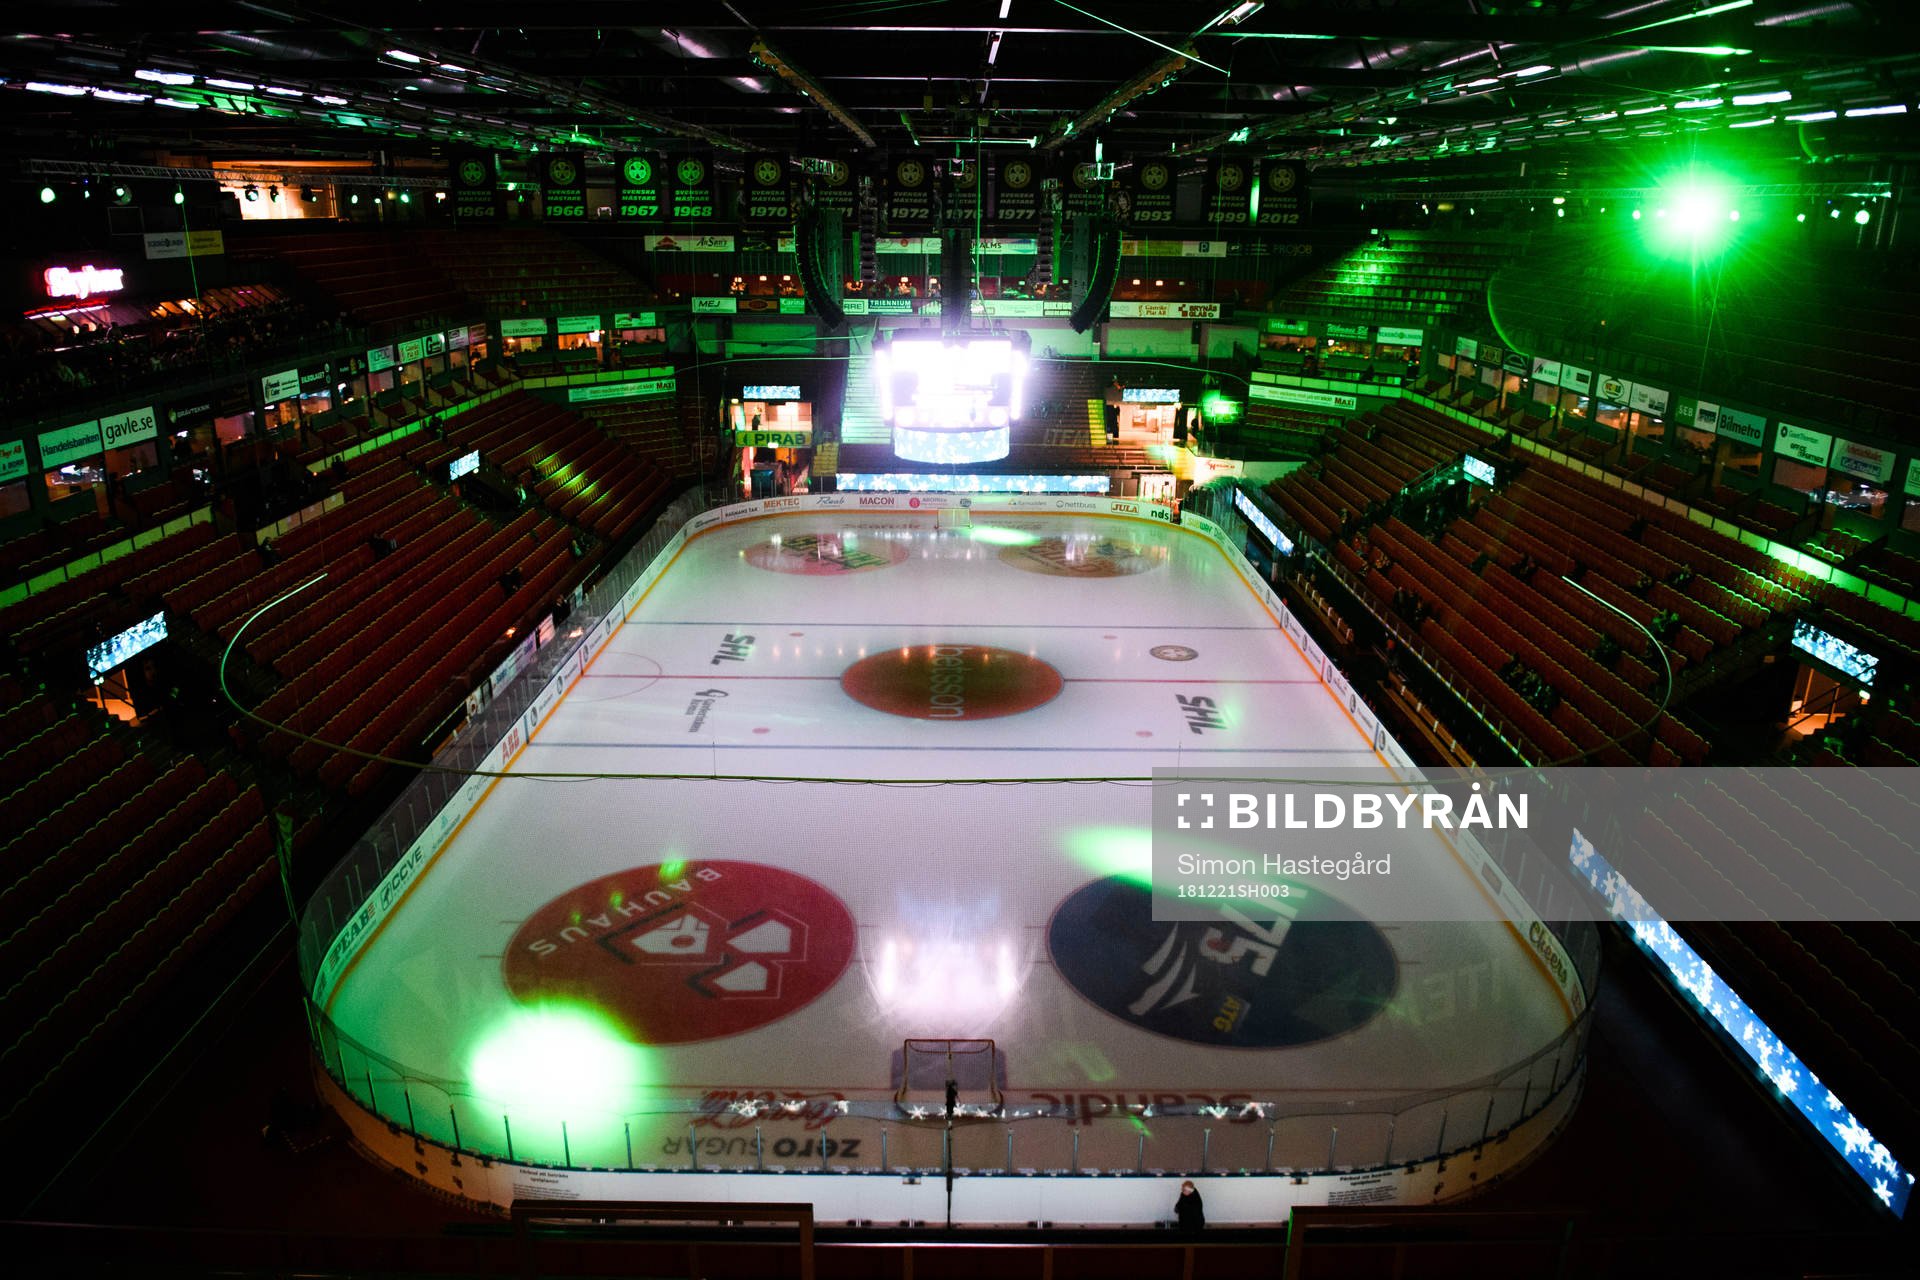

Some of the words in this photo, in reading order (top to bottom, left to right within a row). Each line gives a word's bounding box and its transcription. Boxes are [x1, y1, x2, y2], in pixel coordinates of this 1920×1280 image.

[546, 205, 585, 217] 1966
[621, 204, 659, 217] 1967
[673, 205, 713, 217] 1968
[749, 206, 788, 218] 1970
[891, 208, 929, 220] 1972
[999, 209, 1036, 220] 1977
[1135, 210, 1173, 222] 1993
[1261, 212, 1300, 225] 2012
[699, 300, 721, 308] MEJ
[105, 414, 154, 444] gavle.se
[1719, 412, 1762, 441] Bilmetro
[41, 432, 100, 458] Handelsbanken
[754, 433, 806, 446] PIRAB
[763, 497, 801, 508] MEKTEC
[859, 496, 896, 507] MACON
[1112, 503, 1138, 514] JULA
[1151, 509, 1170, 521] nds
[711, 633, 756, 665] SHL
[929, 646, 974, 719] betsson
[1175, 694, 1228, 735] SHL
[502, 727, 520, 764] ABB
[528, 867, 722, 957] BAUHAUS
[1529, 921, 1567, 984] Cheers
[1212, 995, 1244, 1034] ATG
[1032, 1092, 1261, 1127] Scandic
[665, 1139, 769, 1155] SUGAR
[772, 1138, 860, 1158] zero
